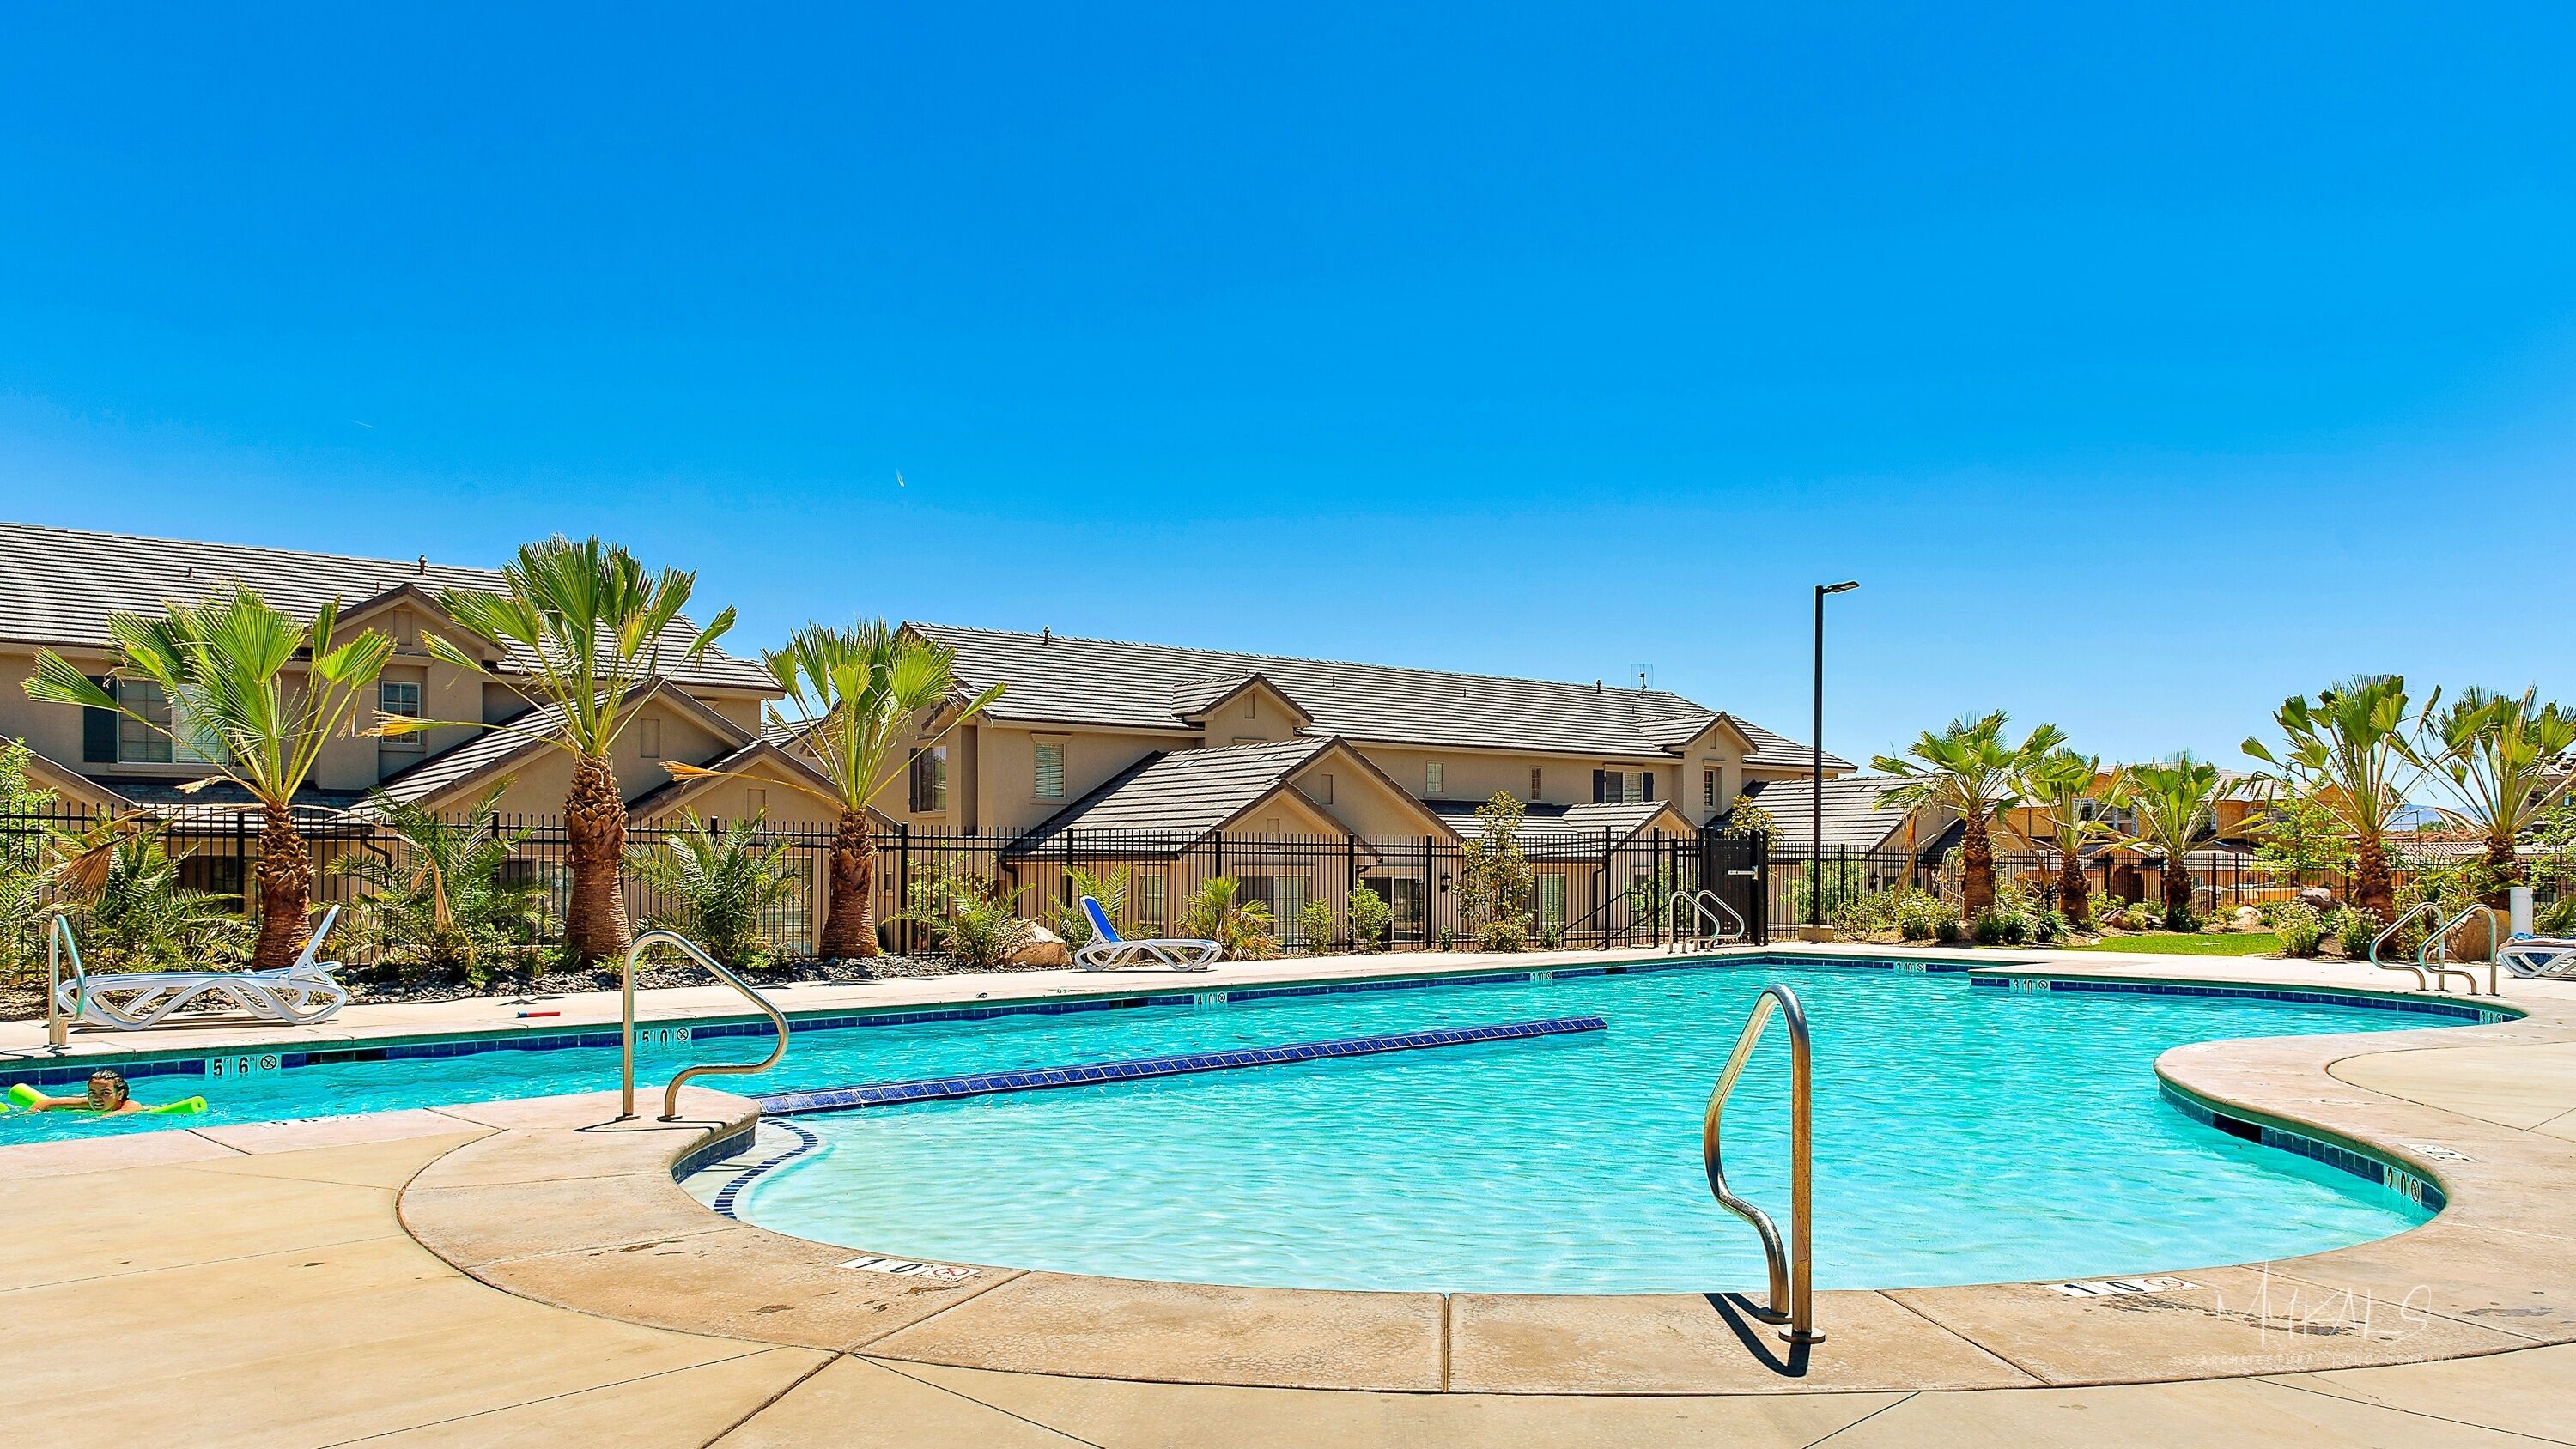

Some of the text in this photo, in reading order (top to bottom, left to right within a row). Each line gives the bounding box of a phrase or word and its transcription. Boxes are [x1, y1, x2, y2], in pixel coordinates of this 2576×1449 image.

[641, 1030, 651, 1043] 5
[213, 1056, 249, 1076] 5 6
